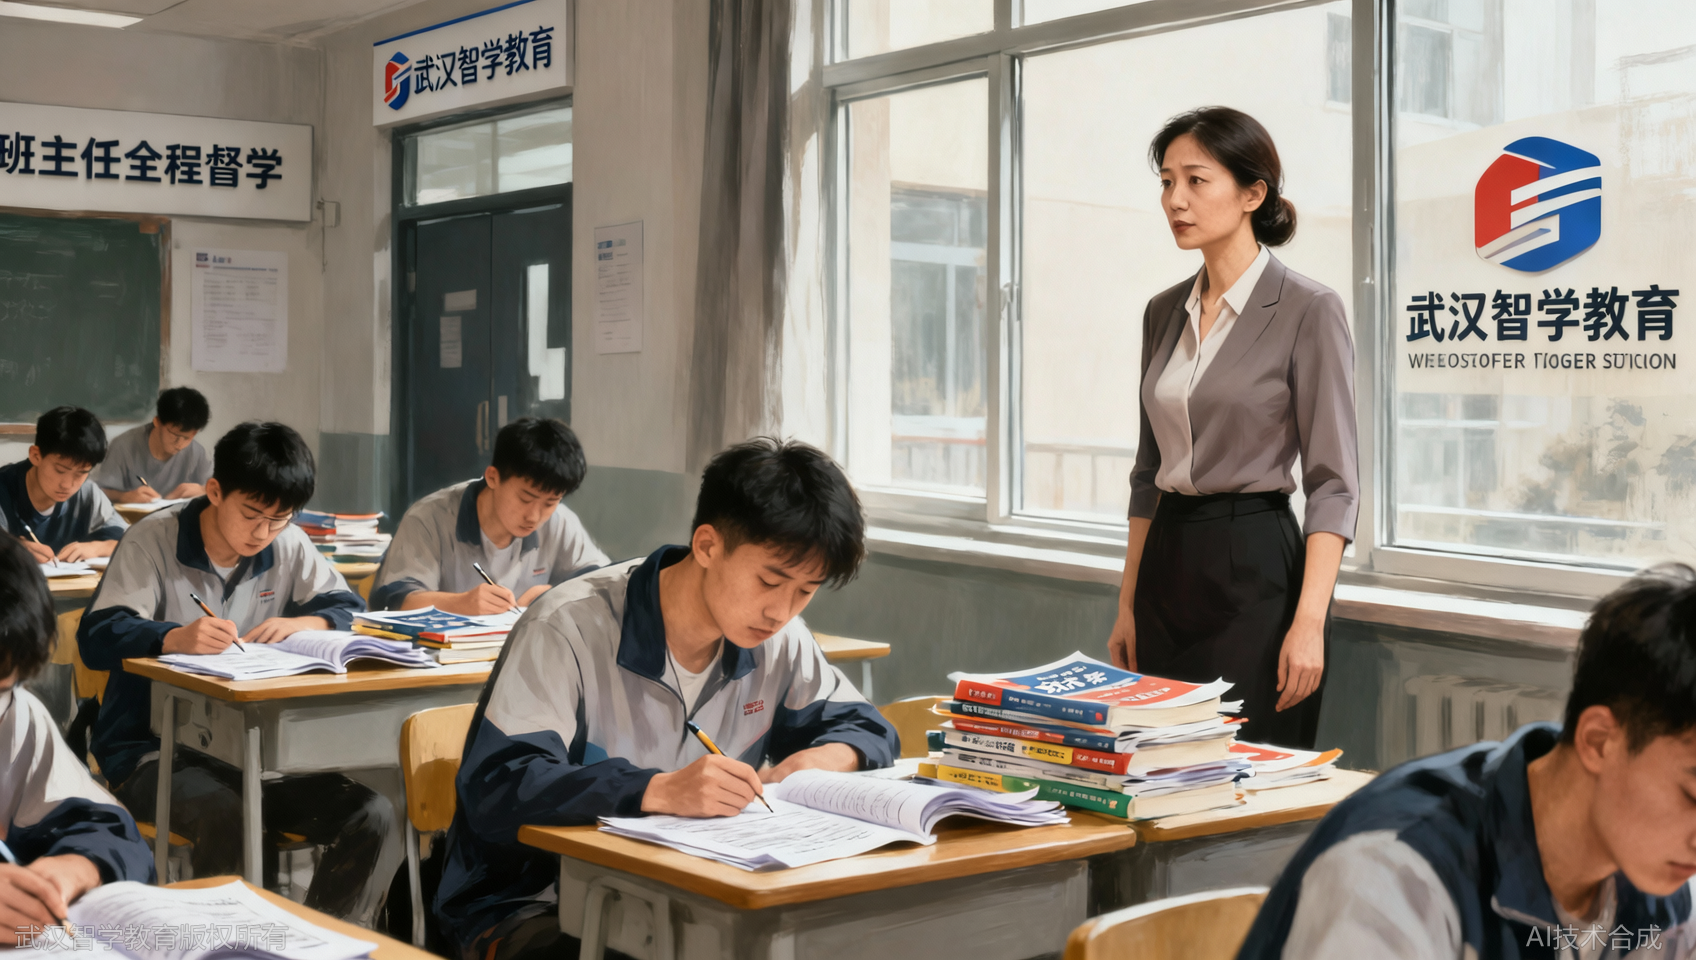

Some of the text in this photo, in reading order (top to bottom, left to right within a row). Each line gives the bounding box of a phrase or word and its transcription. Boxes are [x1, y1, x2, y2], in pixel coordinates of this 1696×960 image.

[414, 25, 555, 95] 武汉智学教育
[0, 131, 283, 190] 班主任全程督学
[1406, 284, 1680, 343] 武汉智学教育
